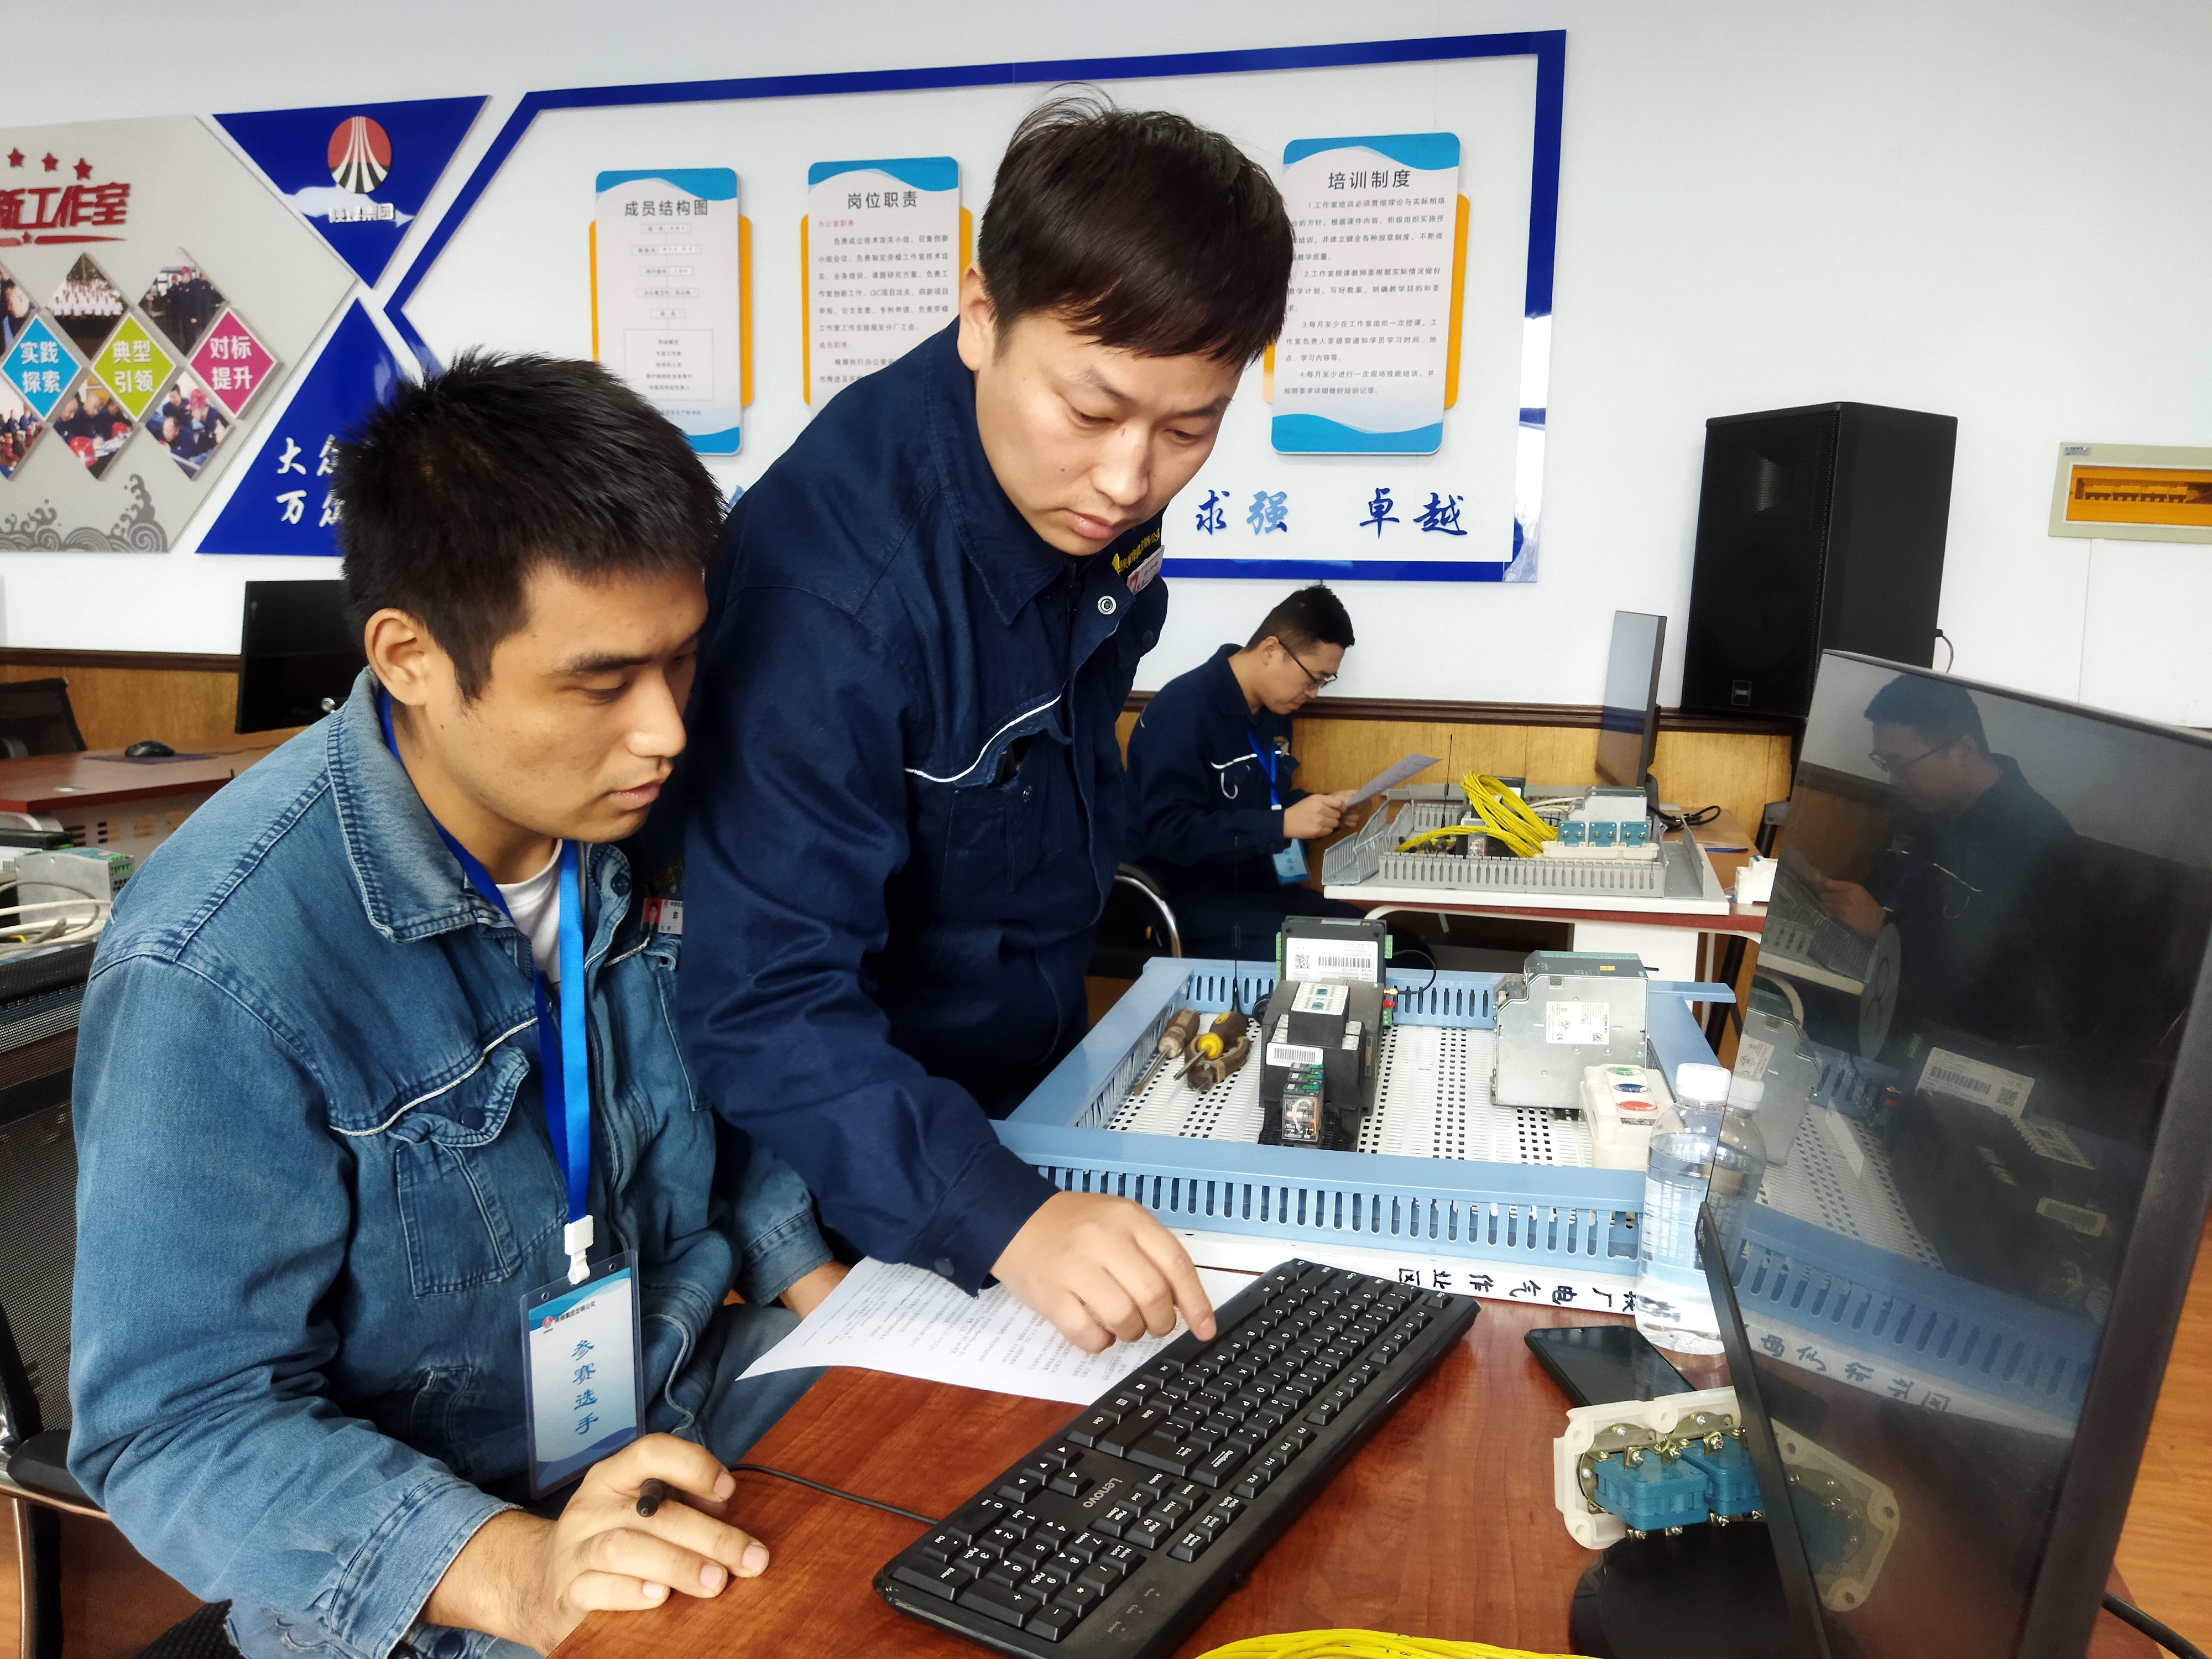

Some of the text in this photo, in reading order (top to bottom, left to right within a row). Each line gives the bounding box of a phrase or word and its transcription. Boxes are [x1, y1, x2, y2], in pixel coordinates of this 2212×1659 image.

[1328, 169, 1411, 190] 培训制度
[847, 190, 918, 210] 岗位职责
[624, 199, 708, 217] 成员结构图
[20, 340, 59, 364] 实践
[113, 340, 153, 364] 典型
[210, 335, 252, 360] 对标
[22, 370, 61, 394] 探索
[114, 370, 155, 393] 引领
[211, 366, 253, 391] 提升
[1196, 487, 1468, 539] 求强 卓越
[571, 1339, 599, 1435] 参赛选手
[1141, 1409, 1154, 1418] Shift
[1093, 1416, 1104, 1425] Ctrl
[1180, 1447, 1192, 1457] Enter
[1280, 1442, 1291, 1451] F10
[1212, 1449, 1234, 1468] BackSpace
[1264, 1457, 1276, 1466] F11
[1148, 1473, 1163, 1484] Delete
[1246, 1474, 1259, 1483] F12
[1082, 1477, 1124, 1509] Lenovo
[1181, 1484, 1195, 1495] Insert
[1131, 1492, 1142, 1501] End
[1105, 1506, 1122, 1520] Down
[1162, 1501, 1177, 1512] Home
[1011, 1509, 1024, 1519] End
[1113, 1507, 1128, 1521] Page
[1201, 1515, 1215, 1526] Lock
[1143, 1519, 1155, 1528] Up
[1146, 1520, 1161, 1532] Page
[1206, 1515, 1222, 1528] Scroll
[934, 1535, 946, 1543] Del
[1074, 1532, 1091, 1544] Home
[1181, 1533, 1196, 1546] Break
[1186, 1533, 1202, 1547] Pause
[963, 1547, 980, 1559] PgDn
[1109, 1545, 1125, 1558] Lock
[1117, 1545, 1135, 1558] Num
[940, 1567, 956, 1579] Enter
[1030, 1572, 1046, 1584] PgUp
